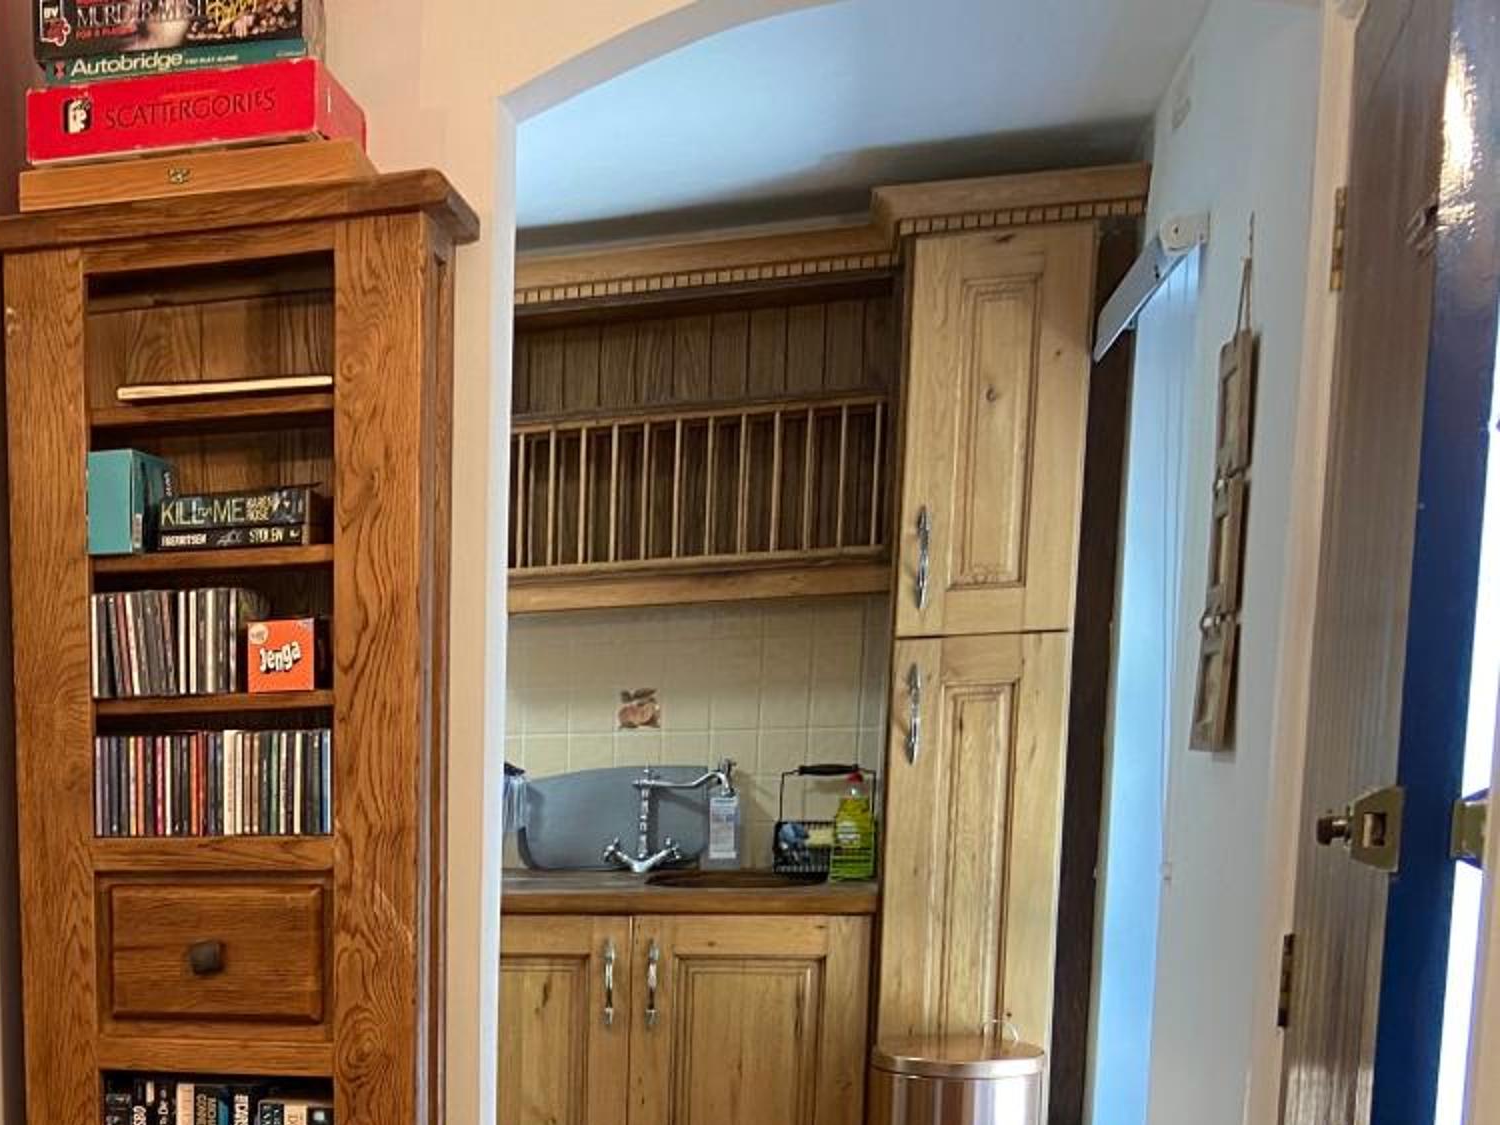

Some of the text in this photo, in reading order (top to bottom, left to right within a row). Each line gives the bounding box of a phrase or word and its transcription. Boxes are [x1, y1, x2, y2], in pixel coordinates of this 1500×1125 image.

[77, 1, 154, 28] MURDER
[72, 51, 183, 76] Autobridge
[104, 88, 276, 130] SCATTERGORIES
[161, 498, 205, 526] KILL
[213, 496, 245, 523] ME
[259, 641, 302, 673] Jenga
